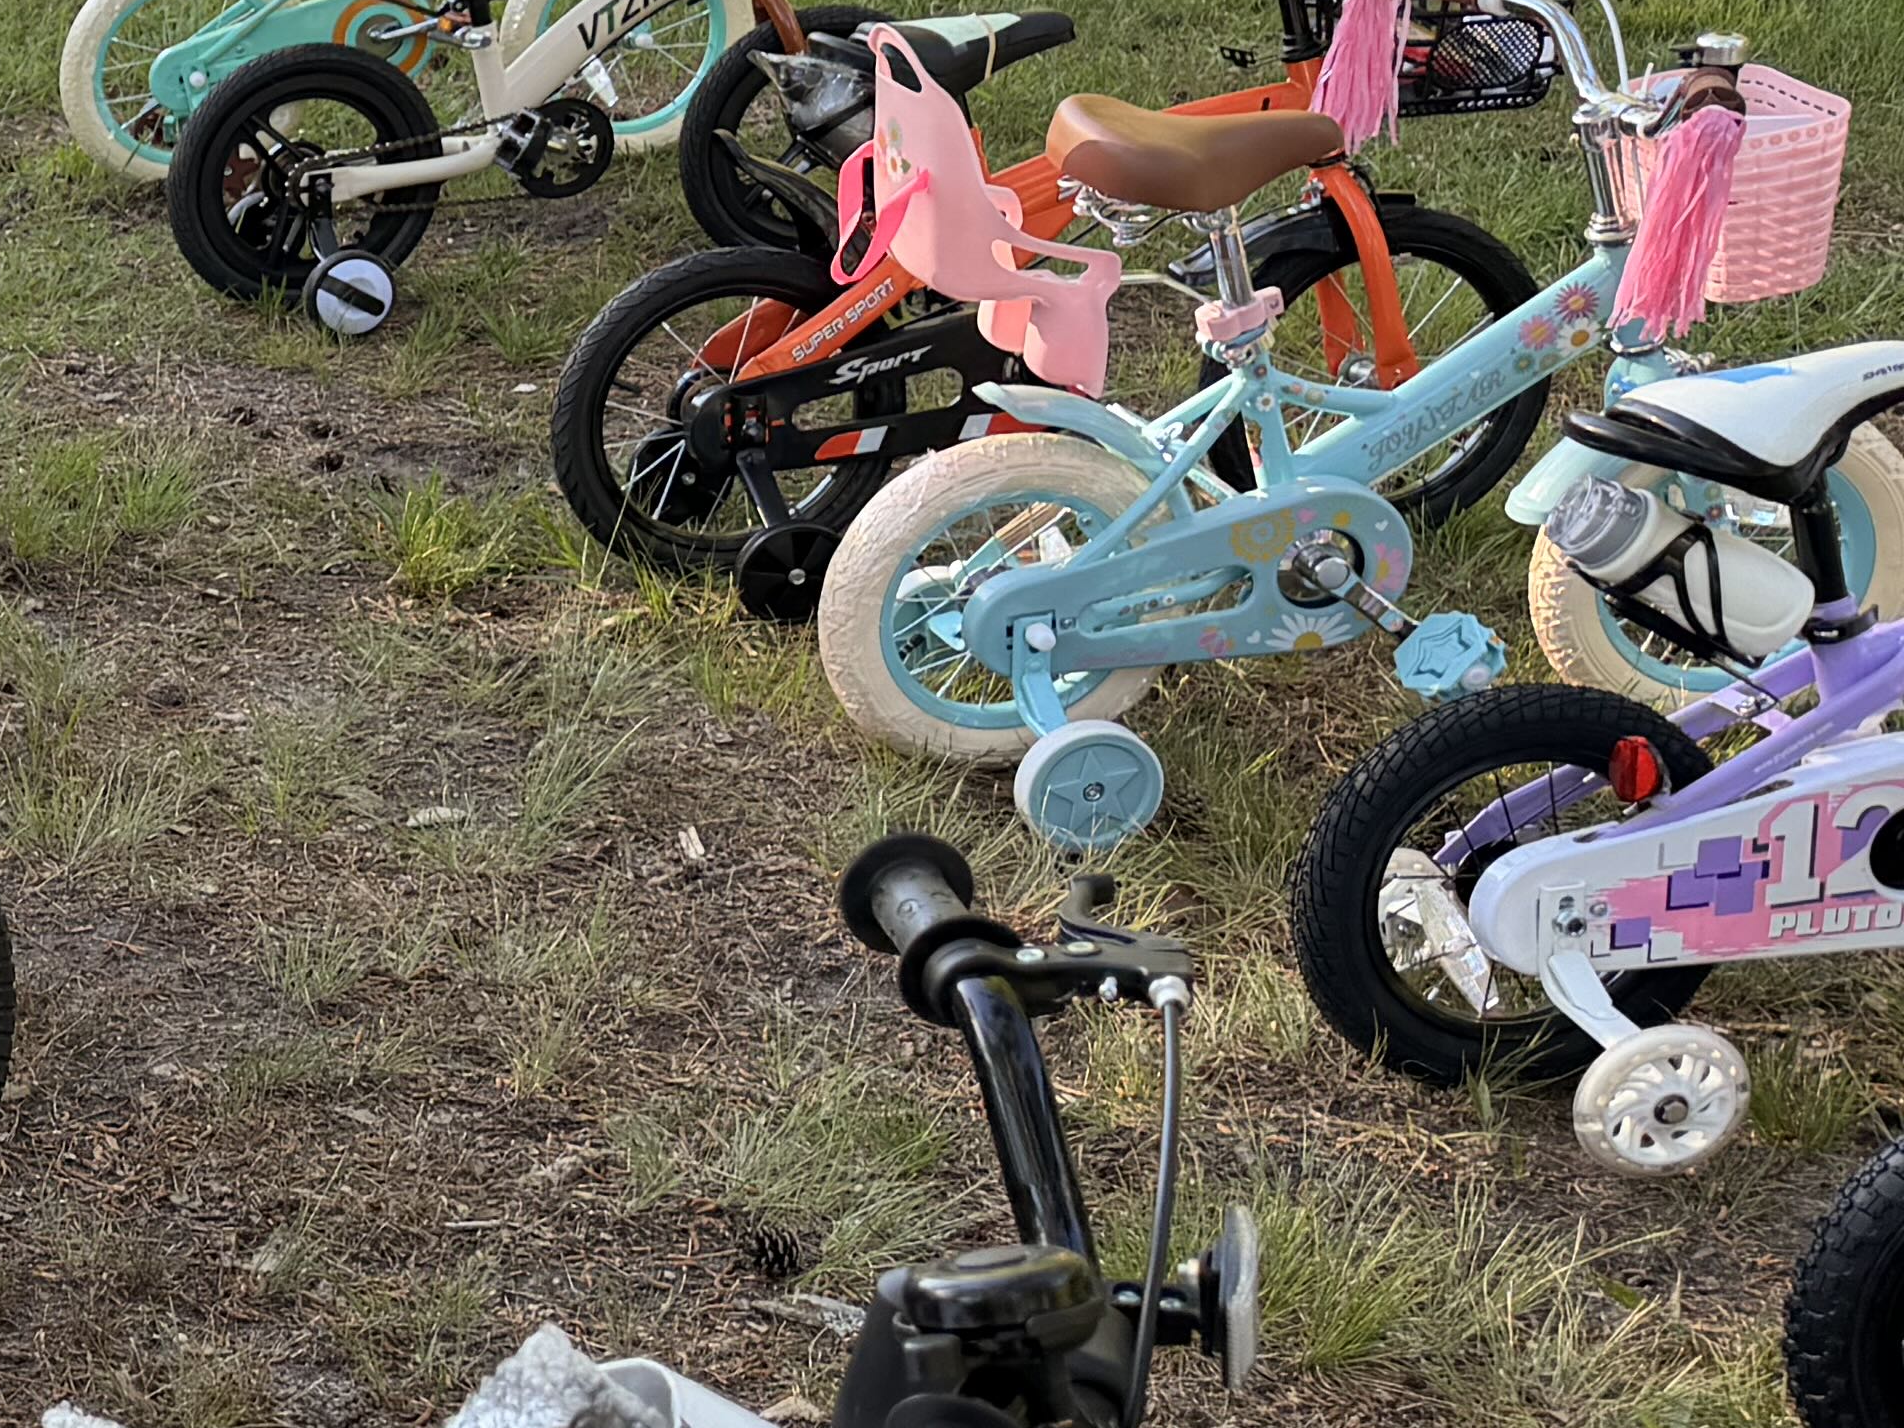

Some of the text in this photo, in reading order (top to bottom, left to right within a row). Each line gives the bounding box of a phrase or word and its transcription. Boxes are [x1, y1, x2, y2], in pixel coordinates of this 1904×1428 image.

[792, 277, 895, 362] SUPER SPORT
[1768, 900, 1903, 939] PLUTO
